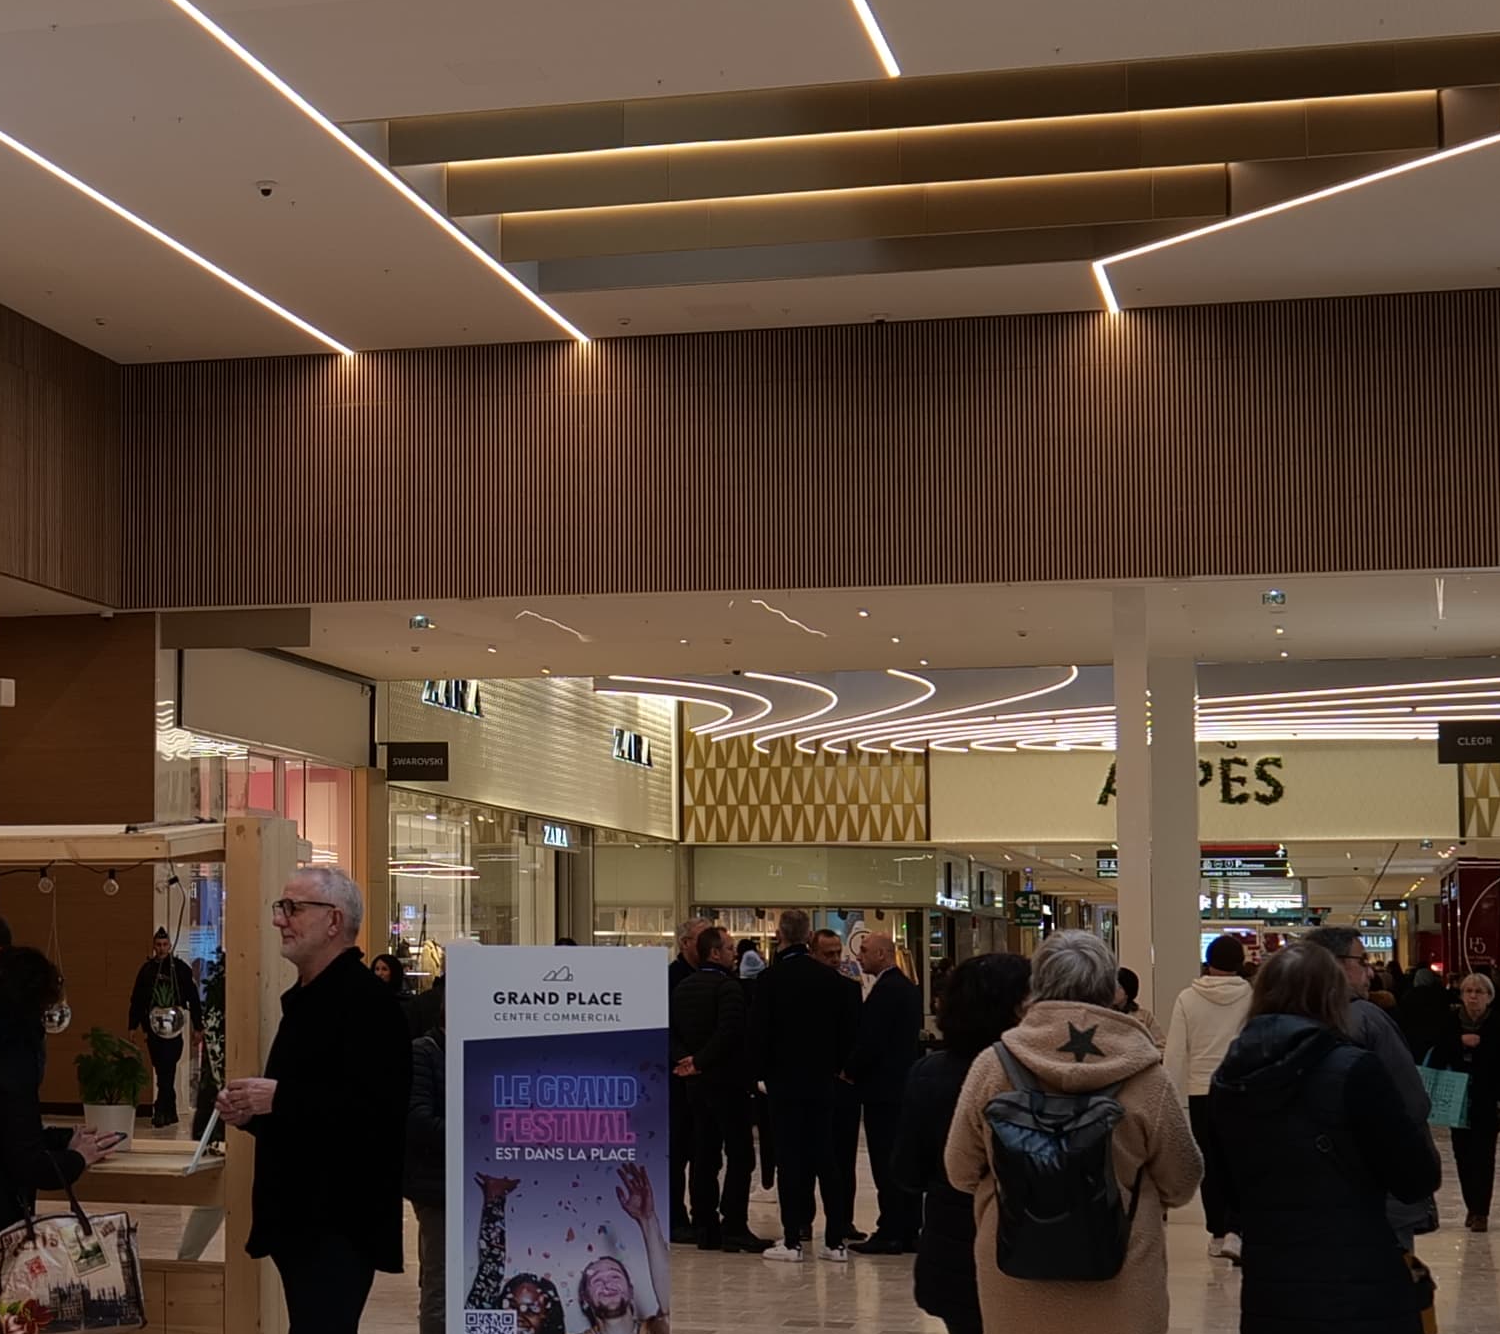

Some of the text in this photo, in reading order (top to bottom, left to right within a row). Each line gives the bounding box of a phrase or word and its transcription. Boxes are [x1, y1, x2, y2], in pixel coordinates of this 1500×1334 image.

[1457, 736, 1493, 747] CLEOR
[392, 755, 445, 768] SWAROVSKI
[543, 825, 569, 848] ZARA
[493, 991, 623, 1006] GRAND PLACE
[493, 1012, 621, 1023] CENTRE COMMERCIAL
[493, 1074, 637, 1108] LE GRAND
[495, 1109, 637, 1144] FESTIVAL
[495, 1147, 637, 1162] EST DANS LA PLACE
